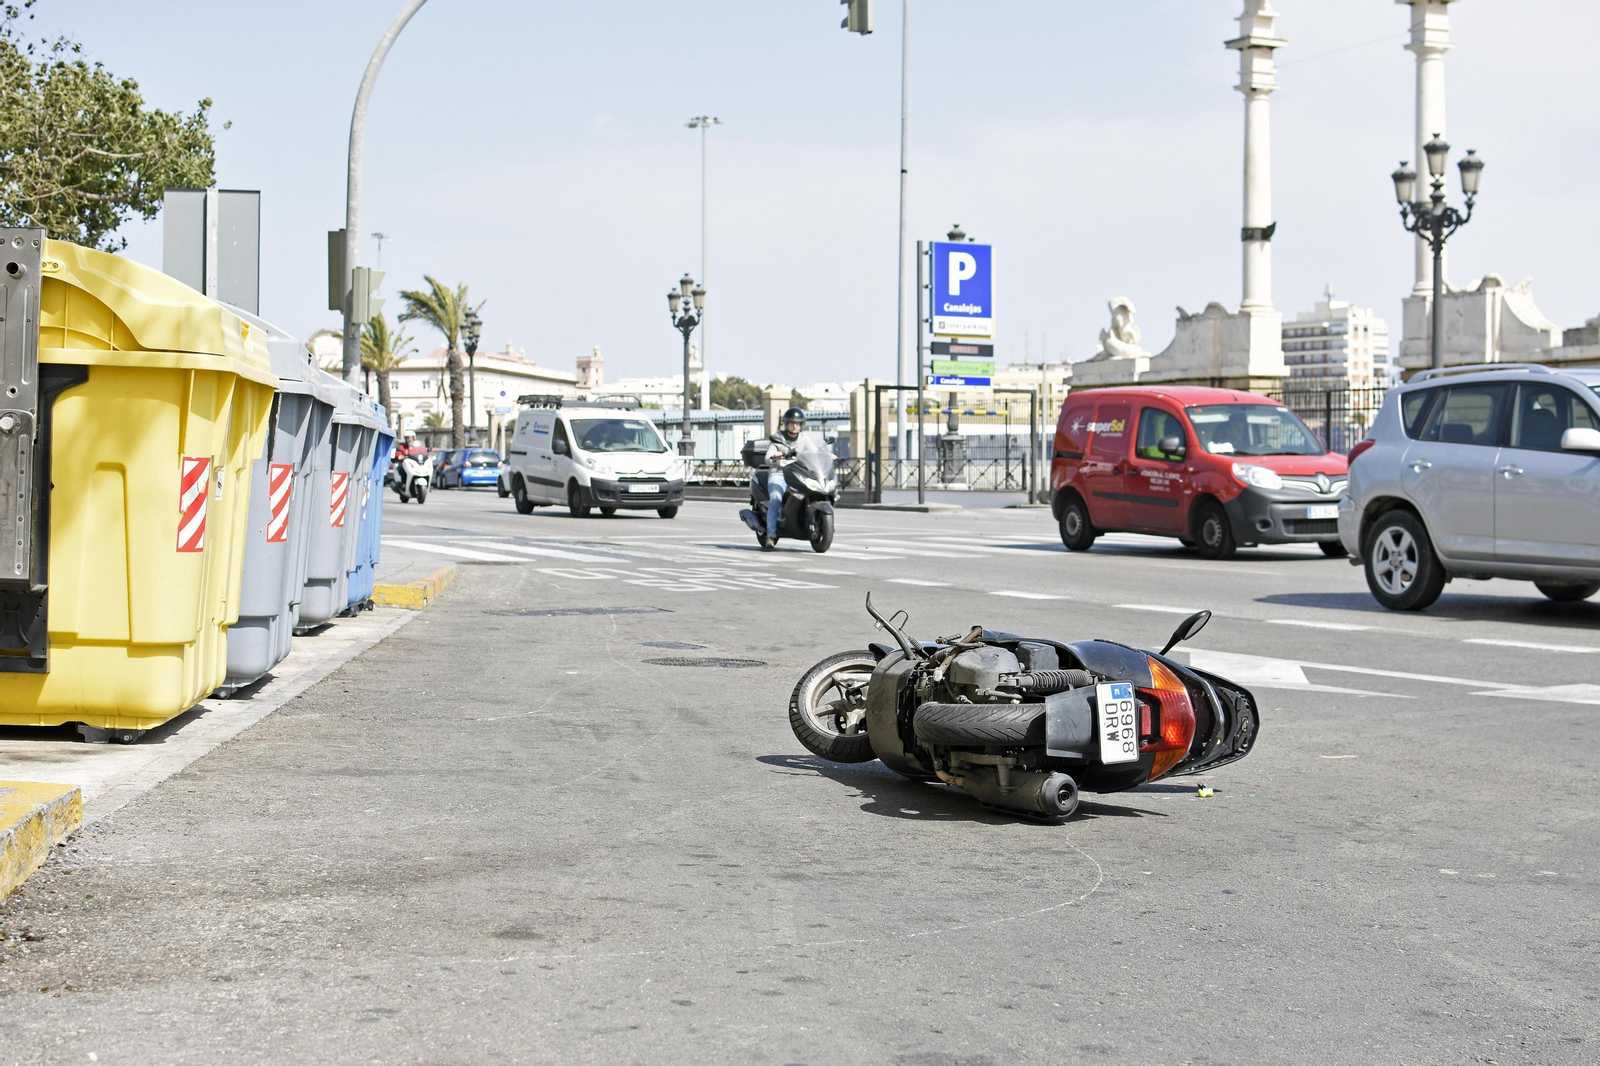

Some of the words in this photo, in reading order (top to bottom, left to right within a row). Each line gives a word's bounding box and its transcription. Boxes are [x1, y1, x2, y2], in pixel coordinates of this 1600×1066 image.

[948, 251, 977, 296] P
[943, 302, 982, 315] Canalejas
[946, 321, 988, 332] interparking
[927, 376, 934, 385] P
[940, 377, 965, 386] Canalejas
[1086, 419, 1125, 435] superSol
[1105, 703, 1120, 742] DRW
[1120, 700, 1135, 752] 6968
